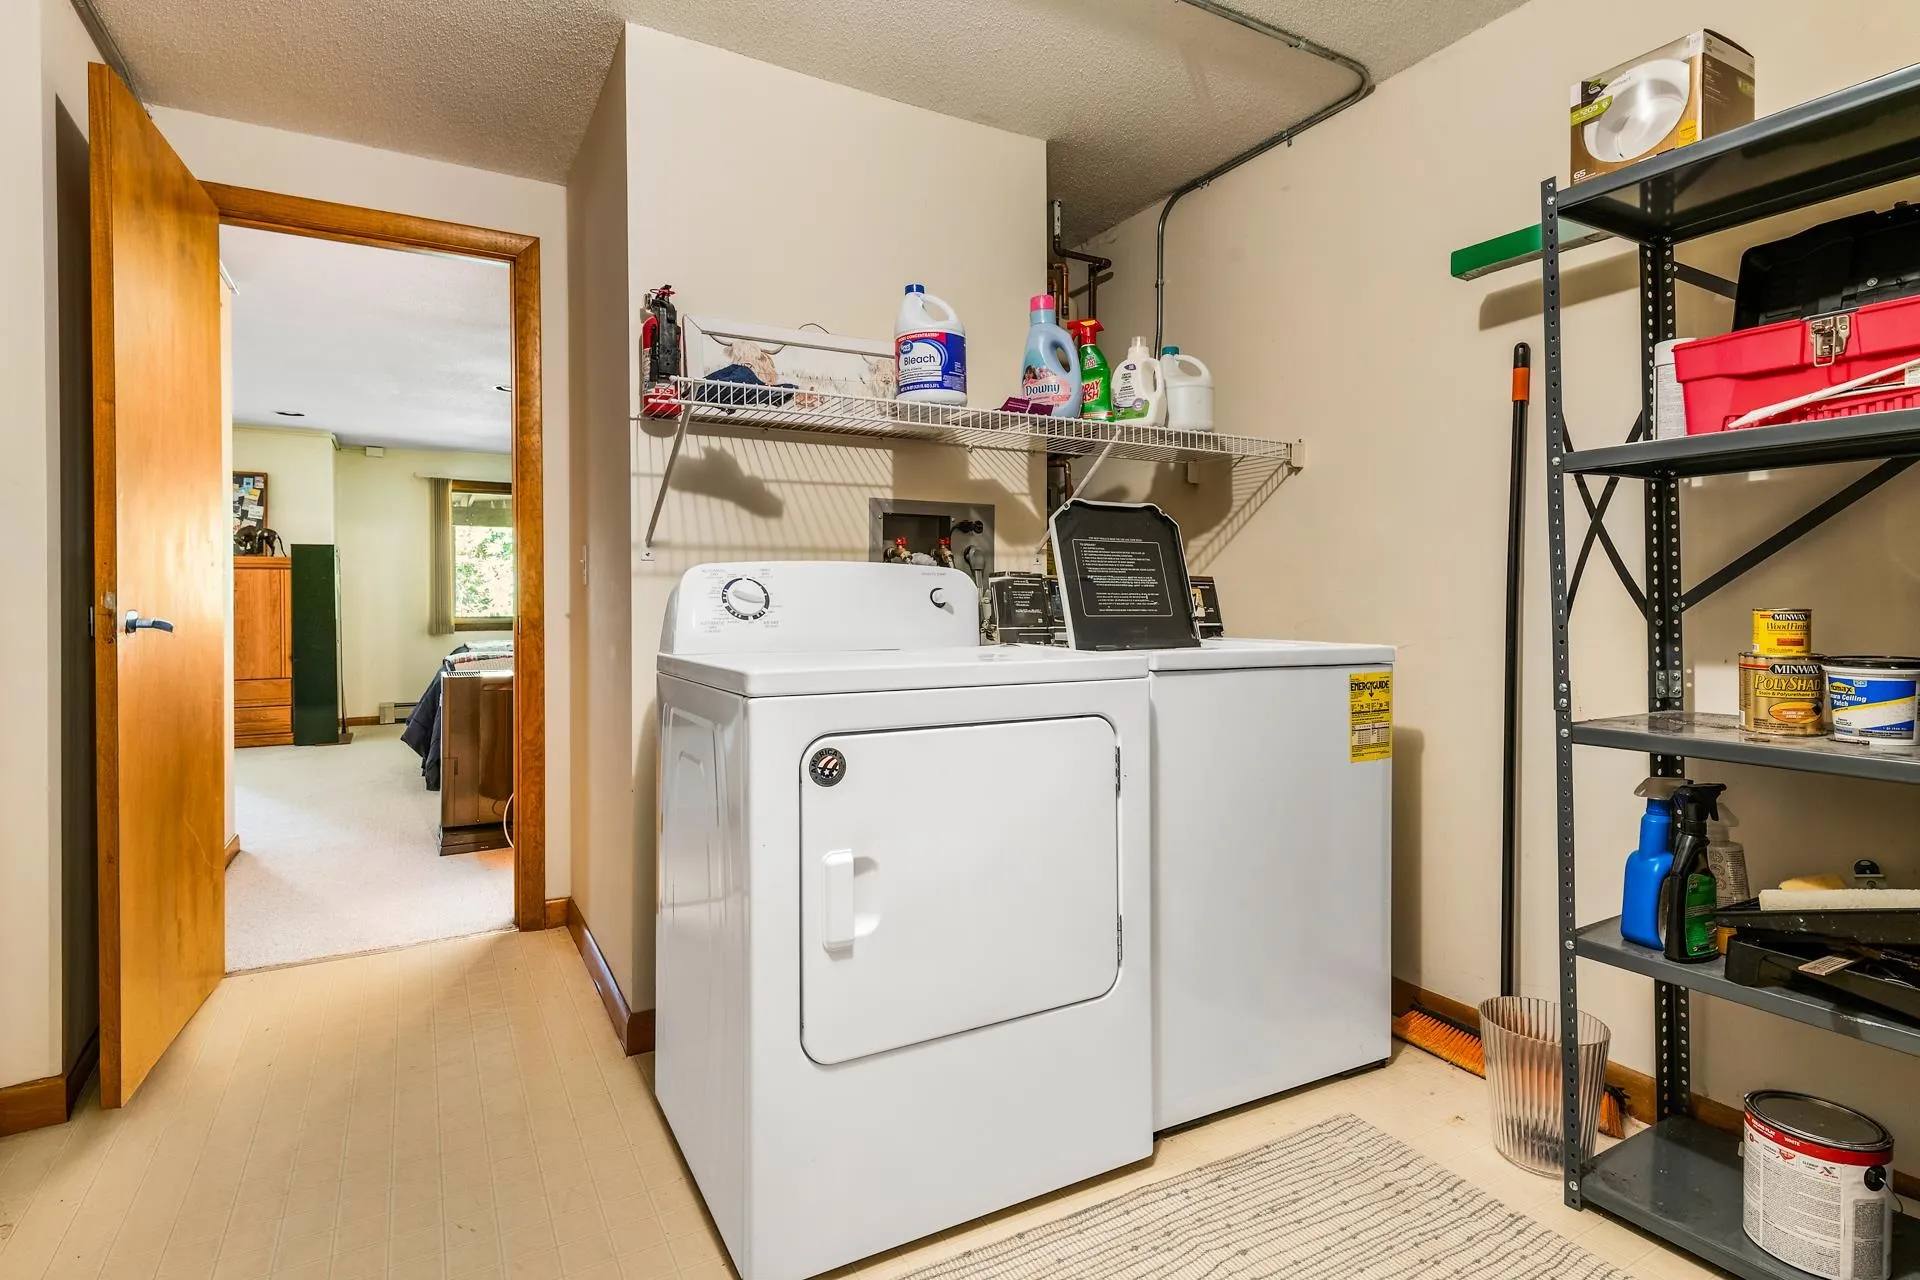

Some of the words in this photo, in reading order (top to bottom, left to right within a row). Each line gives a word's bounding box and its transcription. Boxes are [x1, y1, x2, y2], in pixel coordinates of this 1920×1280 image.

[903, 353, 936, 366] Bleach
[1025, 383, 1060, 397] Downy
[1774, 613, 1807, 621] MINWAX
[1774, 665, 1819, 674] MINWAX
[1841, 694, 1867, 703] Ceiling
